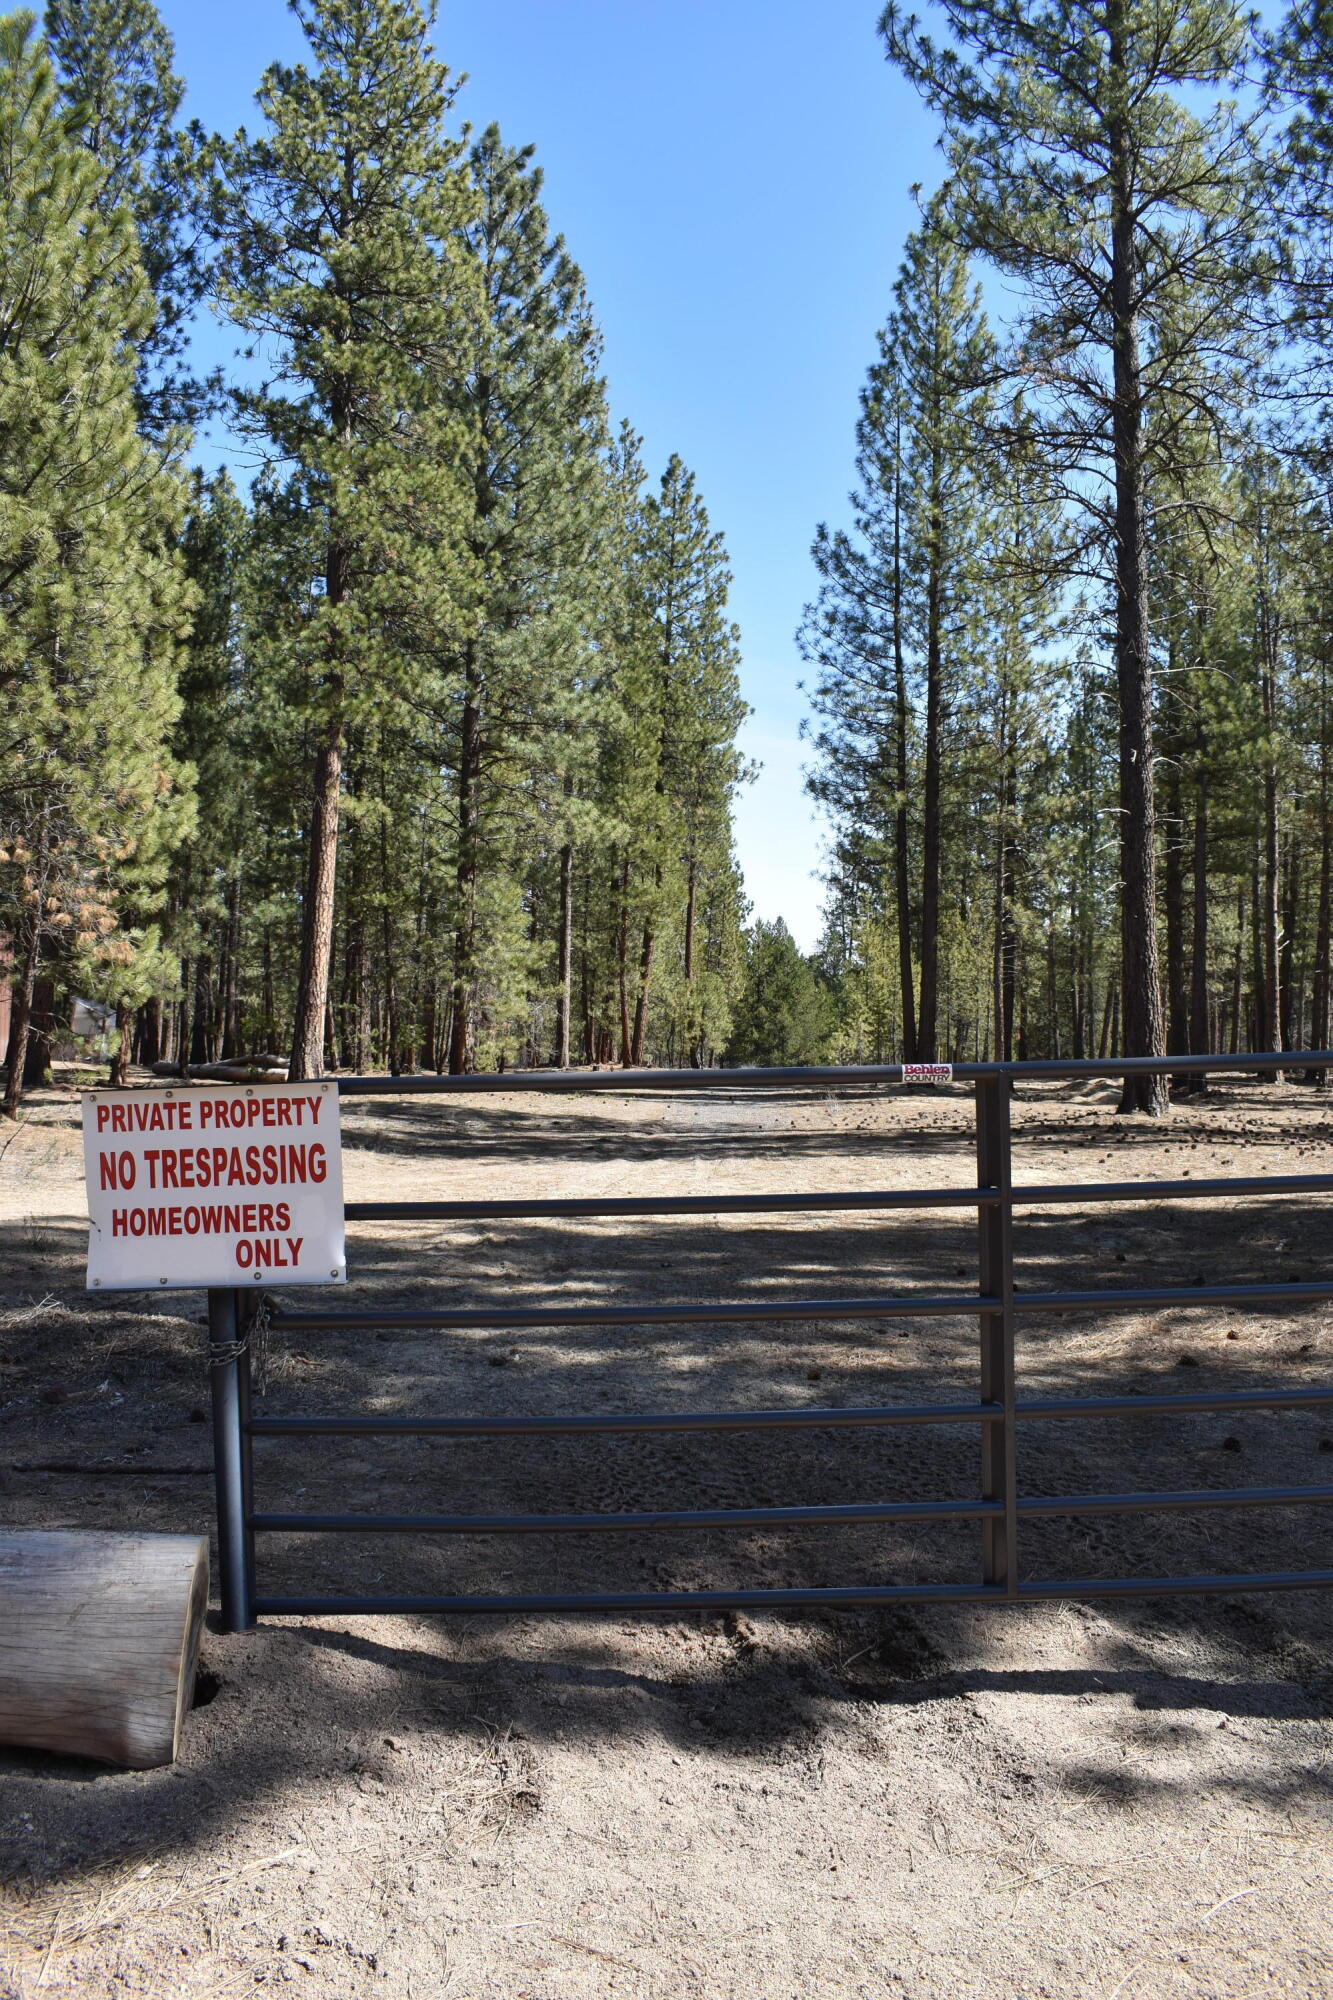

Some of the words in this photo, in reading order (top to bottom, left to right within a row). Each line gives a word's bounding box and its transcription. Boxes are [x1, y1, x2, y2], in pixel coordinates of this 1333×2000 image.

[904, 1064, 950, 1074] Behlen
[904, 1074, 950, 1082] COUNTRY
[97, 1101, 192, 1133] PRIVATE
[200, 1096, 322, 1129] PROPERTY
[100, 1150, 136, 1191] NO
[144, 1143, 327, 1188] TRESPASSING
[112, 1203, 291, 1237] HOMEOWNERS
[235, 1238, 303, 1268] ONLY
